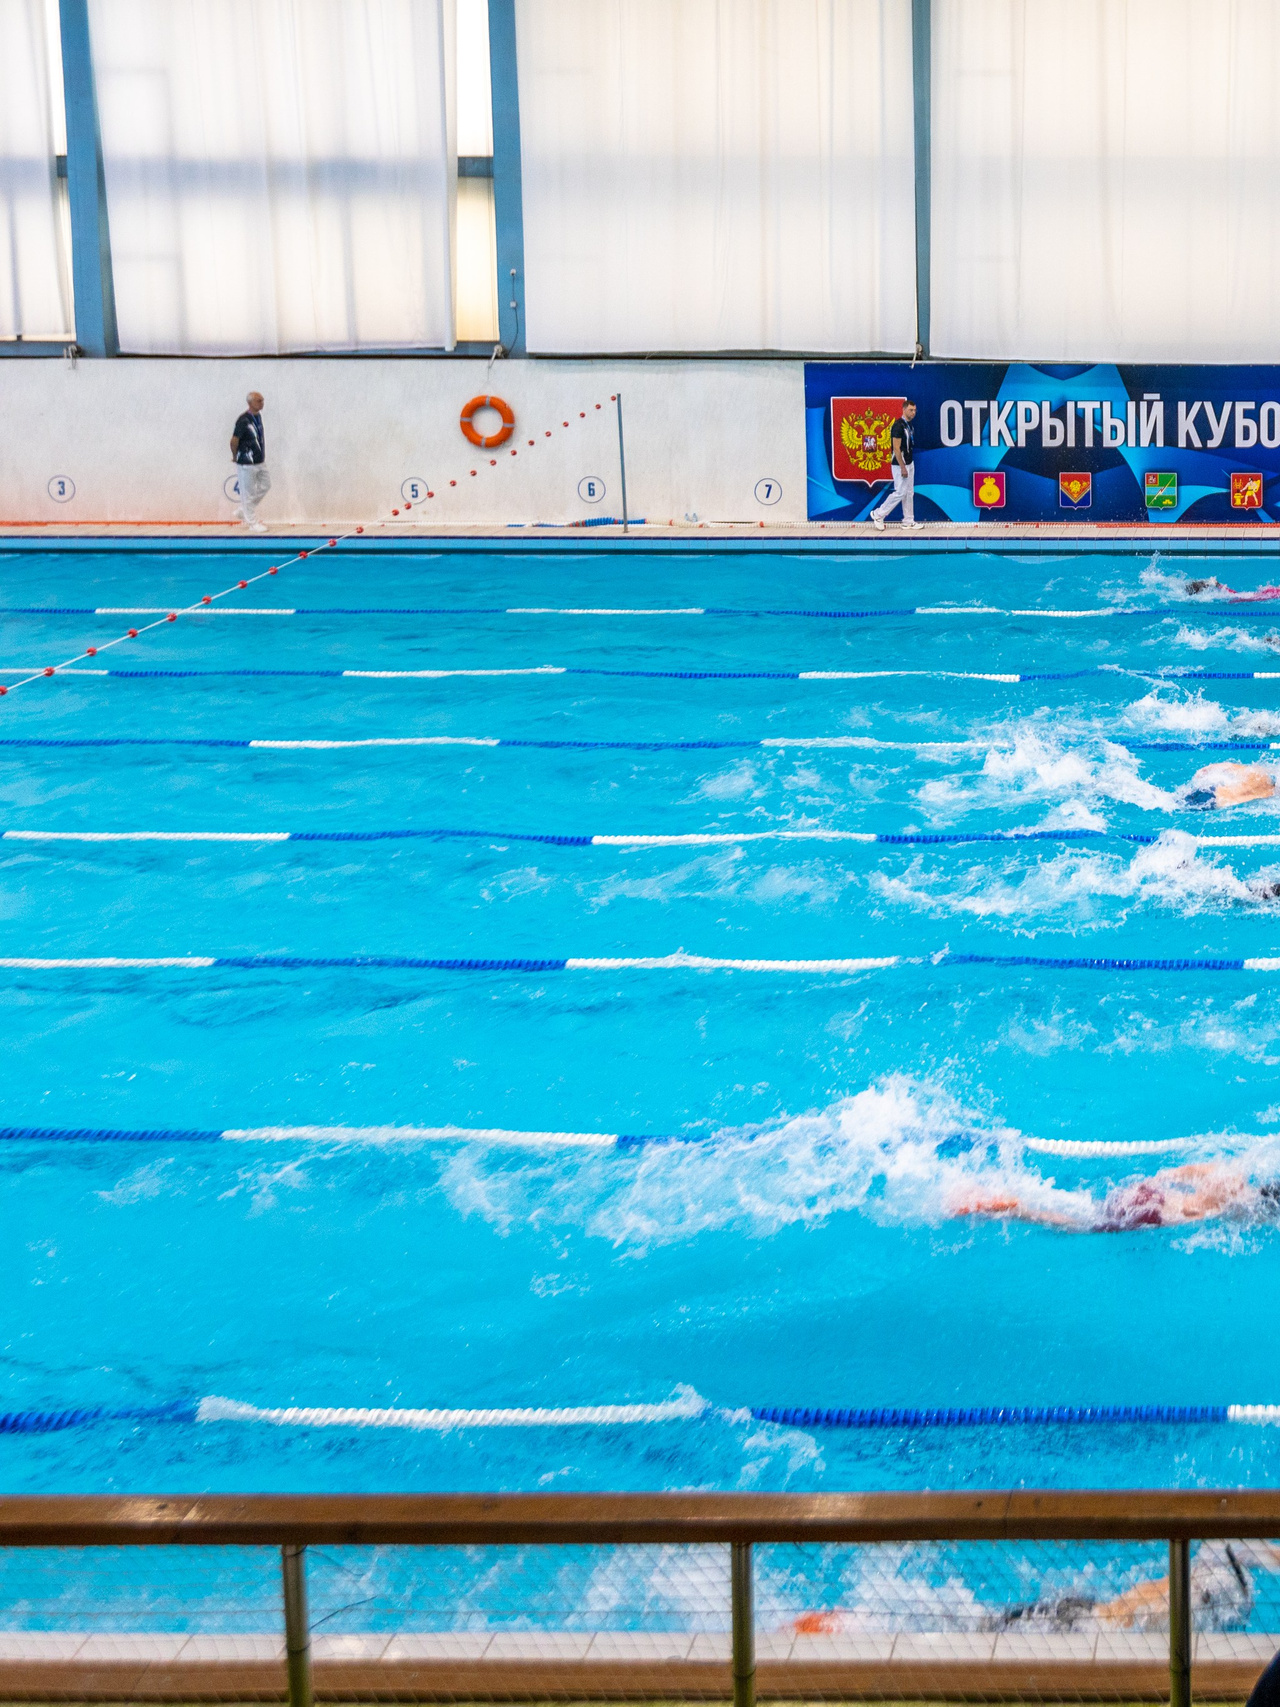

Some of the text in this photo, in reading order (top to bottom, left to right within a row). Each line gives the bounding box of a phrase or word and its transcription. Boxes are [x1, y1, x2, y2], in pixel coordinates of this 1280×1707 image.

[939, 393, 1164, 448] ОТКРЫТЫЙ
[58, 480, 65, 496] 3
[411, 483, 419, 498] 5
[587, 482, 596, 497] 6
[764, 483, 772, 499] 7
